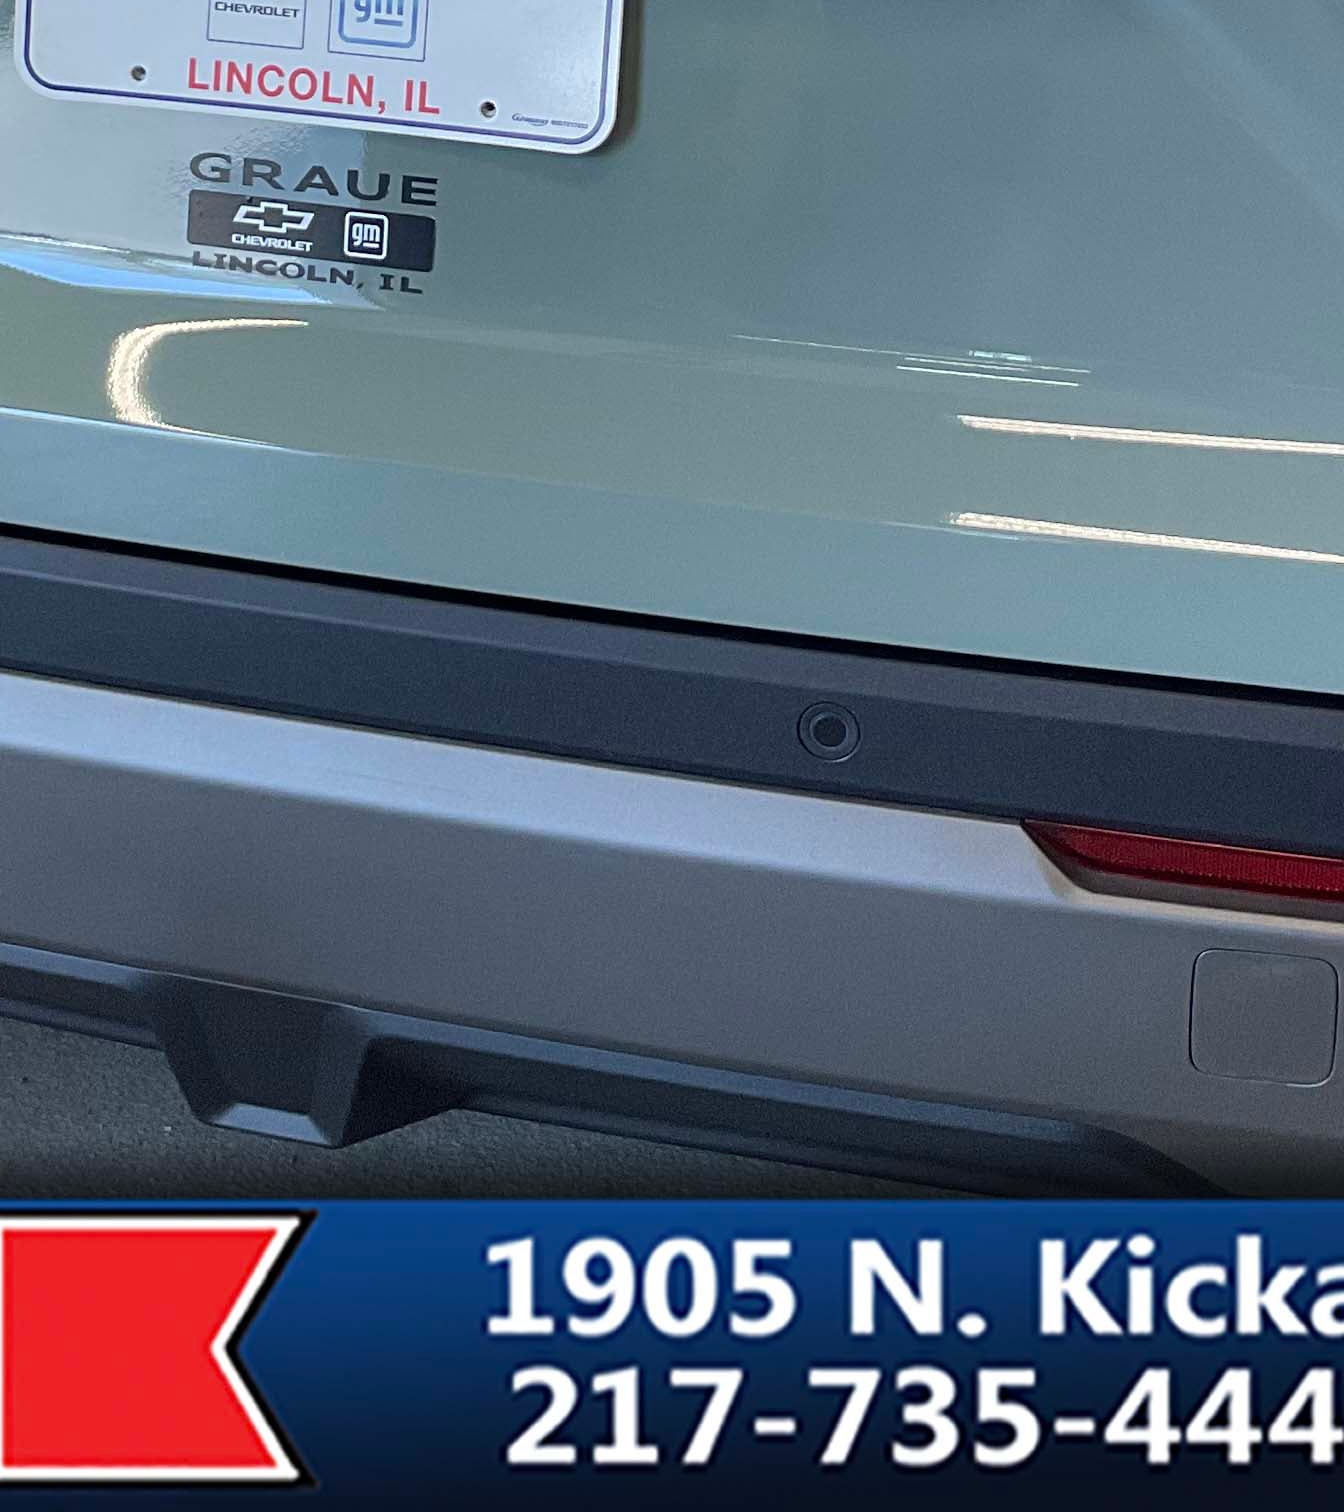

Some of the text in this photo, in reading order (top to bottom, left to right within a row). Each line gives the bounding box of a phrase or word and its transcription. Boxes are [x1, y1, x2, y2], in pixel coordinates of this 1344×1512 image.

[214, 0, 300, 19] CHEVROLET
[187, 56, 441, 115] LINCOLN, IL
[189, 152, 439, 207] GRAUE
[231, 232, 313, 253] CHEVROLET
[351, 220, 381, 249] gm
[192, 249, 423, 294] LINCOLN, IL
